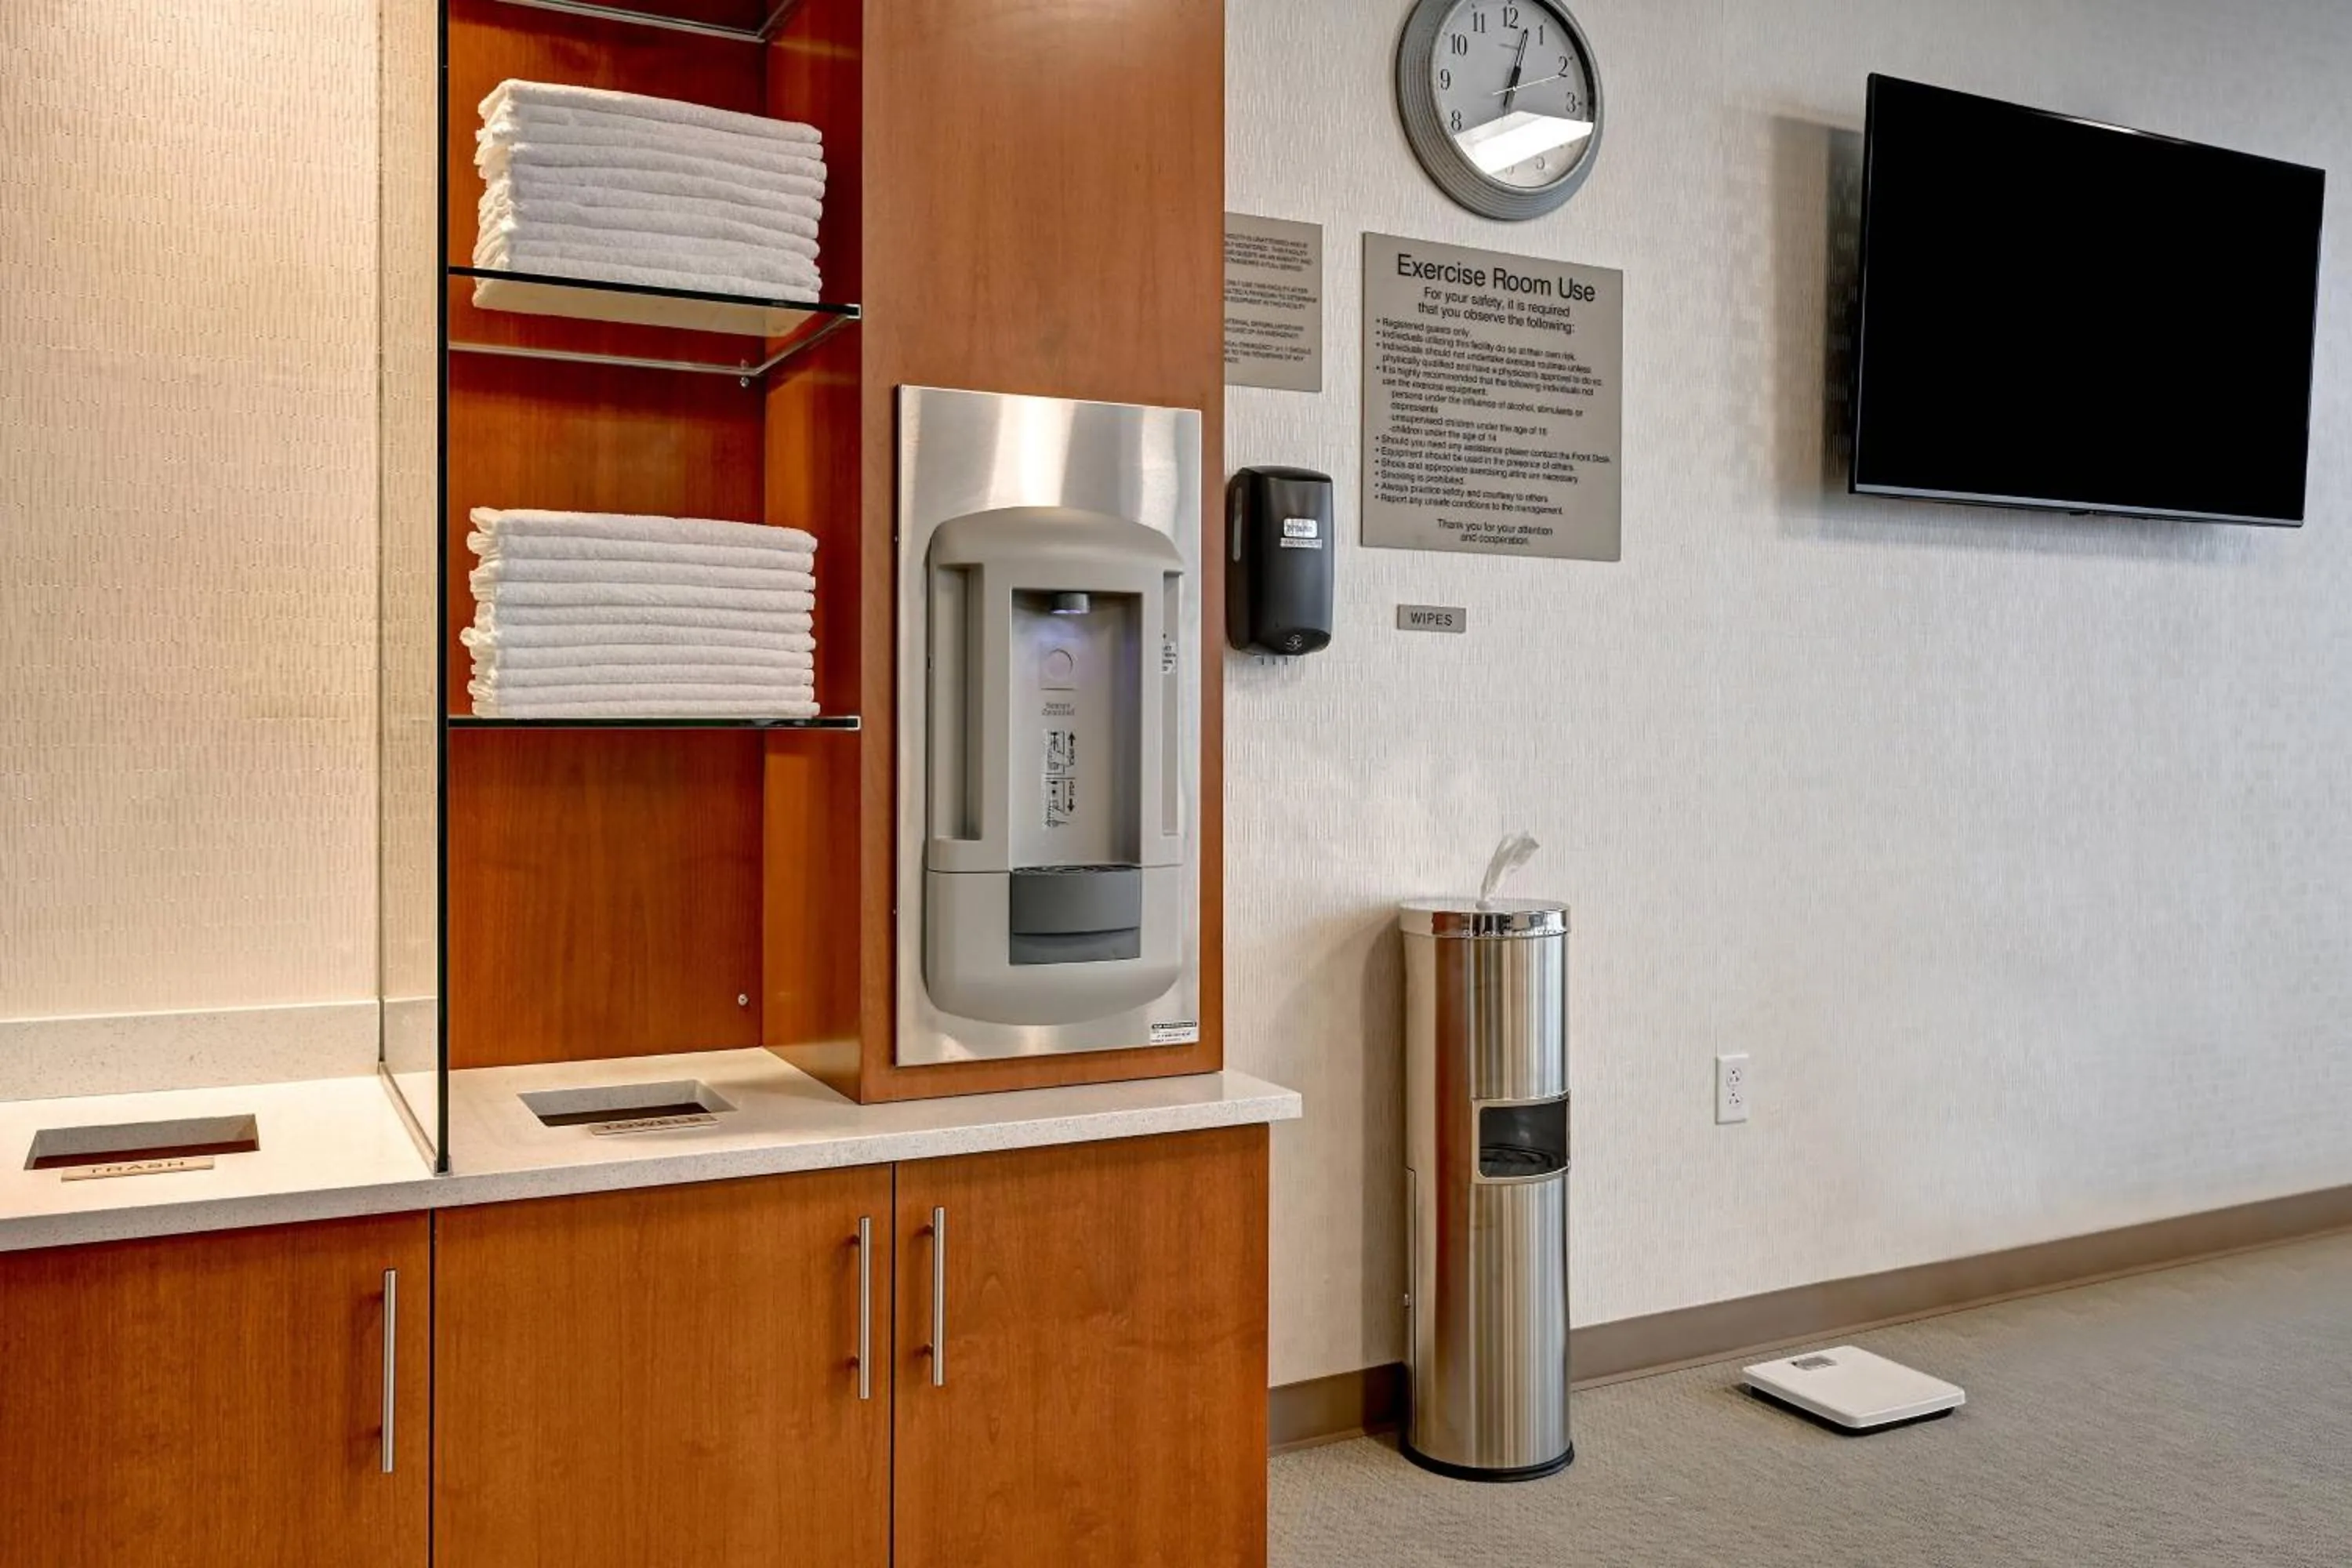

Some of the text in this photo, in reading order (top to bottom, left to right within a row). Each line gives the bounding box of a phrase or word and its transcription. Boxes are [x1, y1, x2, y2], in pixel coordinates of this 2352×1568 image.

[1472, 12, 1486, 33] 11
[1502, 6, 1519, 29] 12
[1451, 34, 1468, 56] 10
[1539, 24, 1544, 45] 1
[1558, 56, 1569, 78] 2
[1440, 69, 1450, 90] 9
[1566, 92, 1576, 113] 3
[1451, 110, 1462, 131] 8
[1396, 253, 1595, 303] Exercise Room Use
[1423, 286, 1441, 300] For
[1444, 292, 1468, 304] your
[1507, 297, 1515, 310] it
[1515, 299, 1526, 312] is
[1526, 303, 1570, 318] required
[1417, 301, 1439, 316] that
[1440, 307, 1461, 319] you
[1463, 308, 1506, 324] observe
[1507, 313, 1526, 327] the
[1410, 612, 1453, 626] WIPES
[92, 1161, 184, 1173] TRASH
